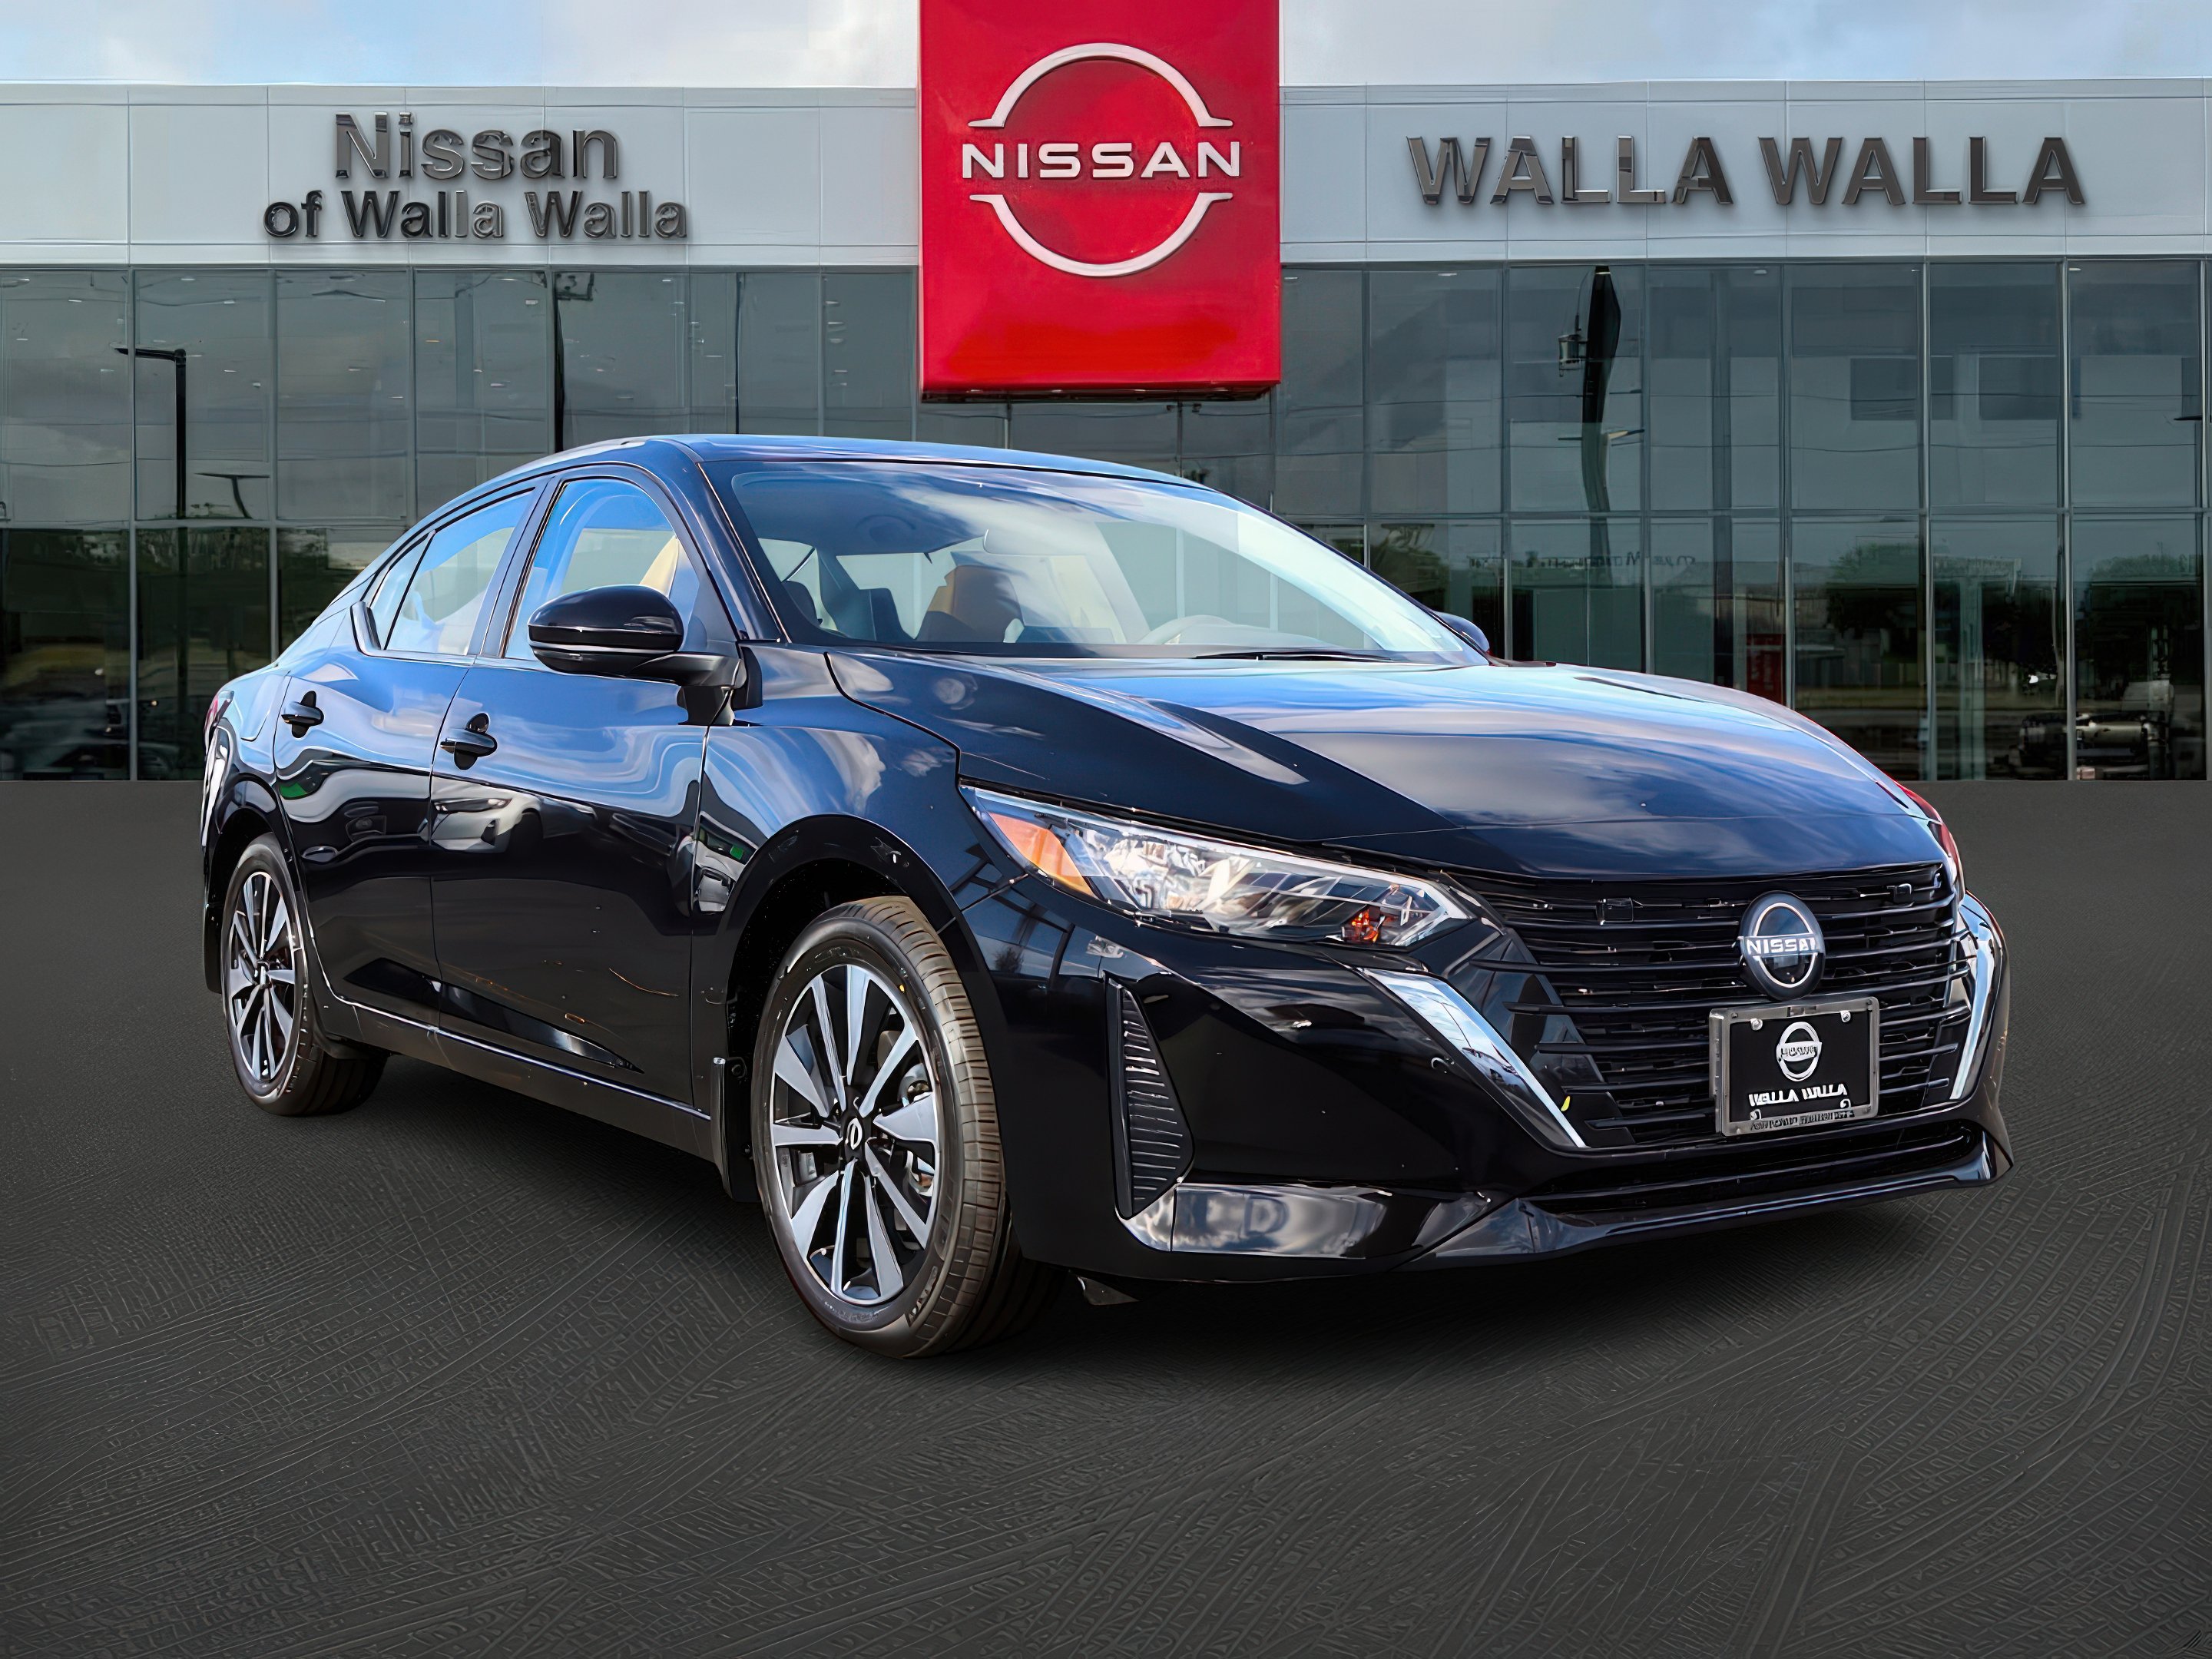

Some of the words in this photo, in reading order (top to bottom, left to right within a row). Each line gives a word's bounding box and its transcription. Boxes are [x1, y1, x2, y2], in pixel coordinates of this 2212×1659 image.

[335, 111, 618, 180] Nissan
[962, 141, 1240, 179] NISSAN
[1406, 135, 1734, 205] WALLA
[1758, 136, 2086, 205] WALLA
[263, 190, 324, 238] of
[341, 190, 505, 239] Walla
[524, 190, 688, 239] Walla
